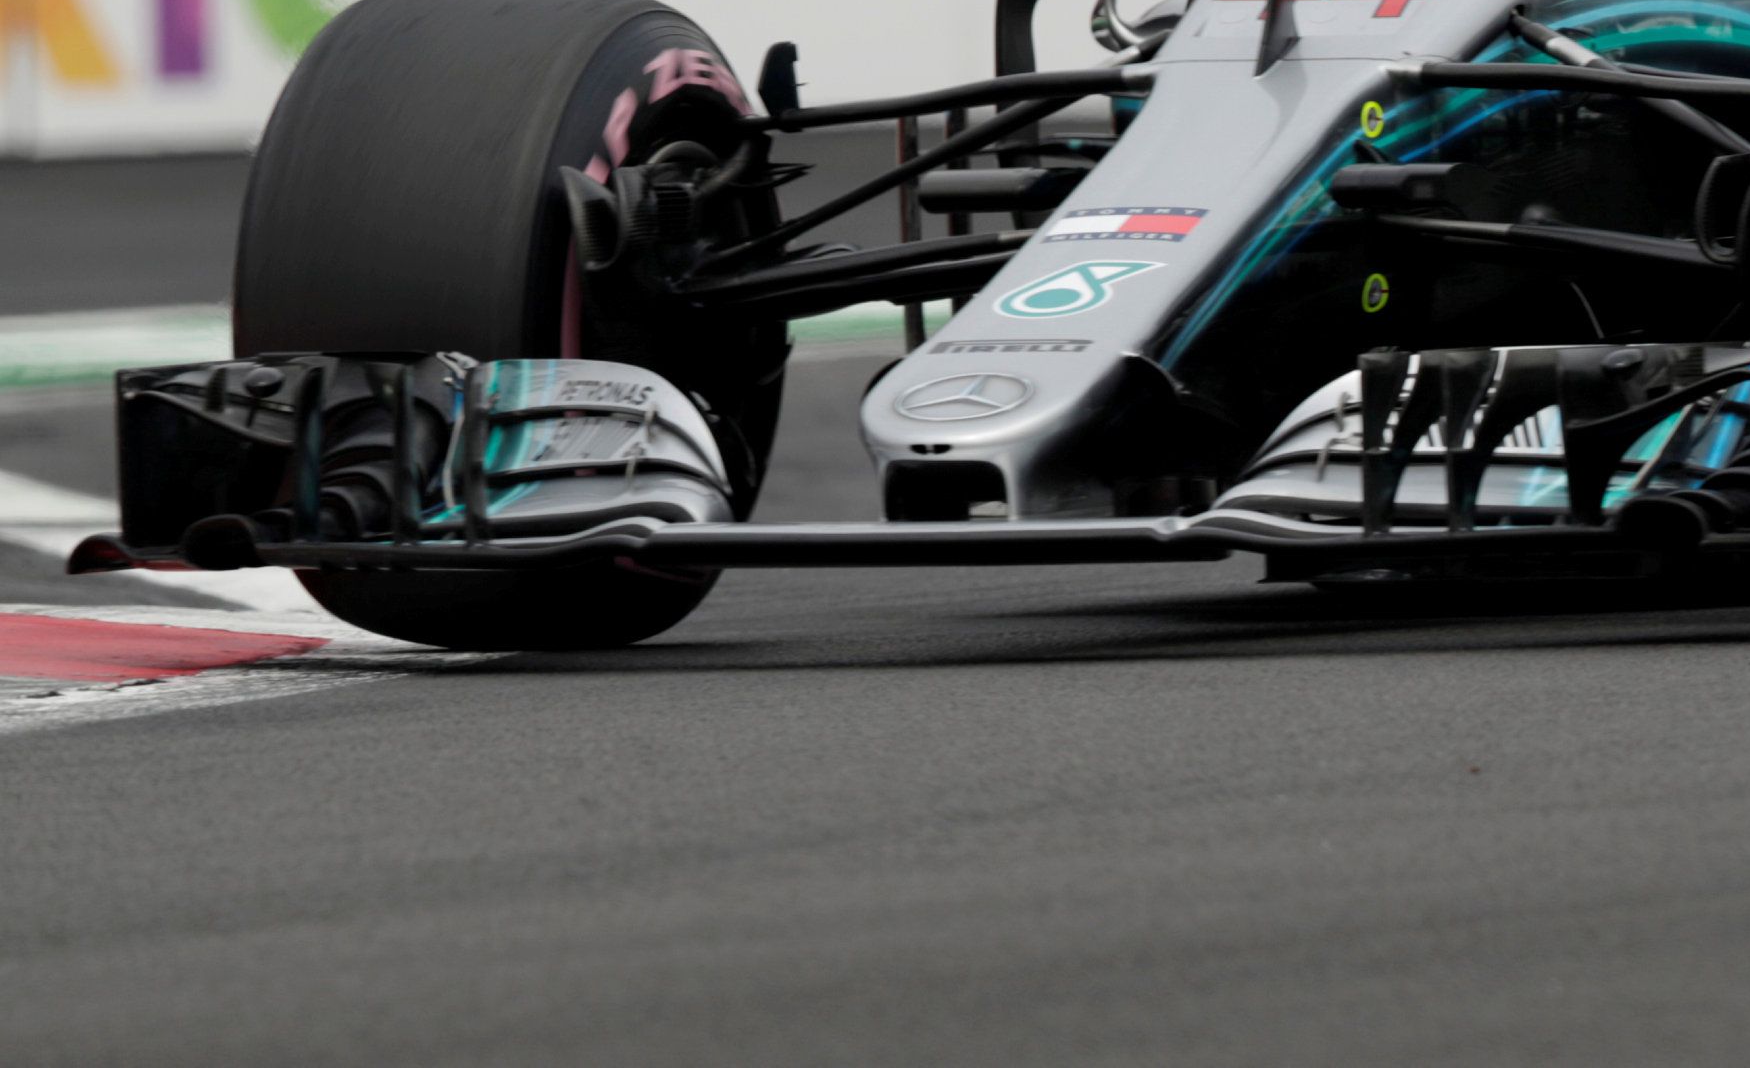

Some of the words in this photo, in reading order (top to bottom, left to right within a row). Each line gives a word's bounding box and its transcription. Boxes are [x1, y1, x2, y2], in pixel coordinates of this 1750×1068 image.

[1074, 207, 1199, 216] TOMMY
[1049, 232, 1174, 241] HILFIGER
[927, 337, 1094, 355] PIRELLI
